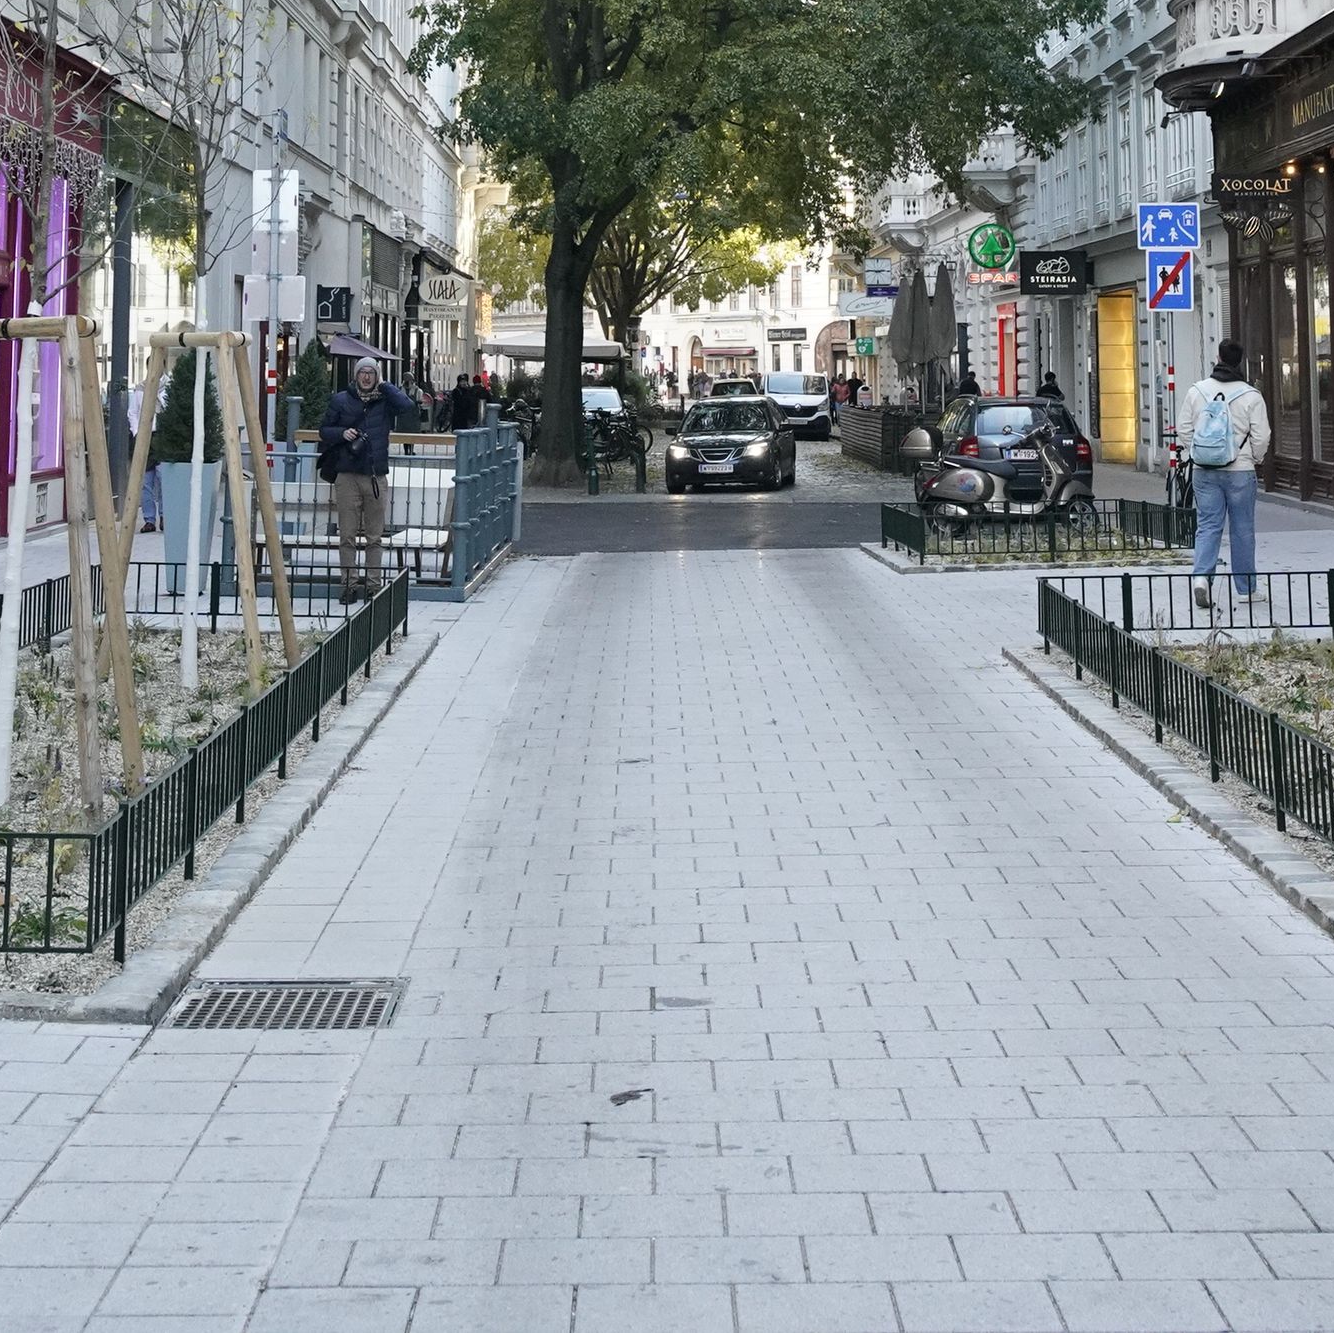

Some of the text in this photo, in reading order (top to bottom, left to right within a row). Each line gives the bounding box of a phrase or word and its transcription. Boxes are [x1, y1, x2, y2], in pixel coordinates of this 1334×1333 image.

[1220, 178, 1292, 193] XOCOLAT
[968, 272, 1019, 284] SPAR
[1030, 275, 1077, 283] STEIRASIA
